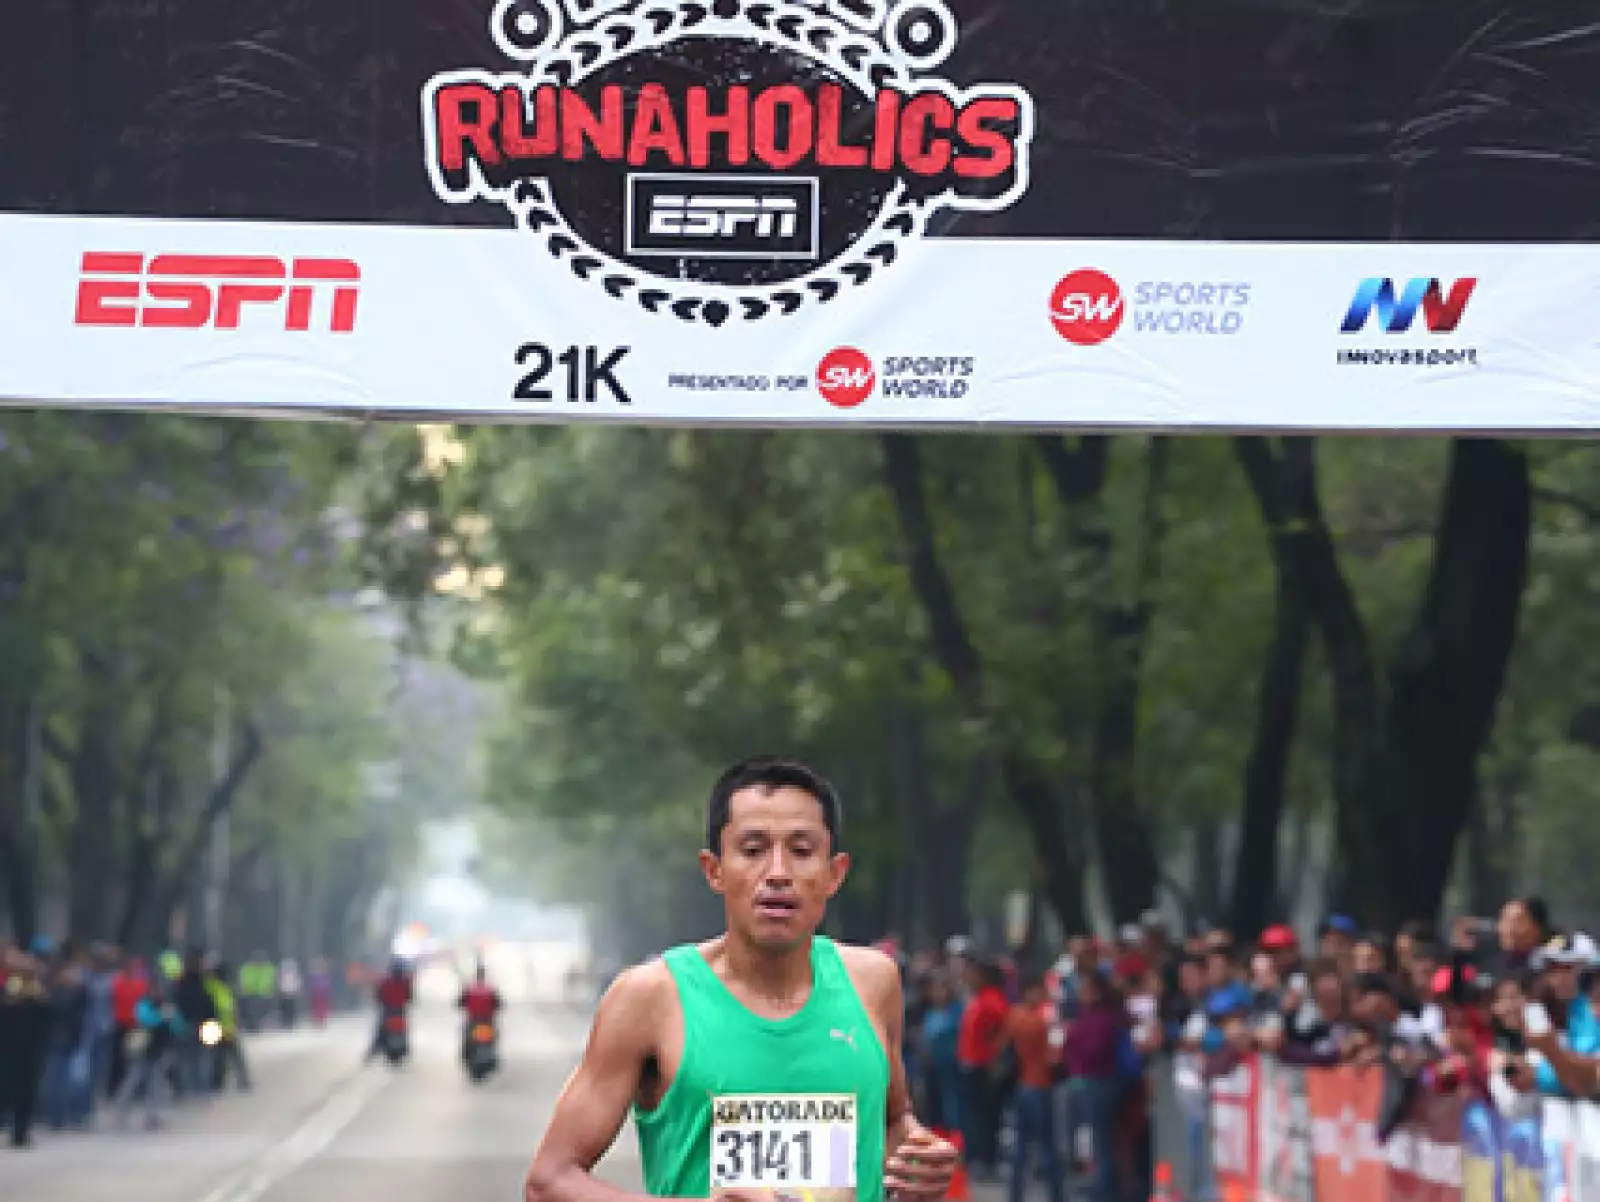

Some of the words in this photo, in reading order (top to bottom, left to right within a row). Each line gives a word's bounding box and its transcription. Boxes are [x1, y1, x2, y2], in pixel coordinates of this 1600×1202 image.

[434, 82, 1019, 178] RUNAHOLICS
[650, 195, 797, 237] ESPN
[75, 252, 361, 333] ESPN
[1134, 281, 1251, 305] SPORTS
[1053, 293, 1121, 321] SW
[1133, 309, 1243, 334] WORLD
[513, 342, 632, 405] 21K
[819, 366, 872, 390] SW
[882, 356, 974, 376] SPORTS
[668, 373, 771, 391] PRESENTADO
[775, 374, 808, 391] POR
[882, 378, 970, 398] WORLD
[716, 1100, 854, 1121] GATORADE
[716, 1130, 813, 1180] 3141
